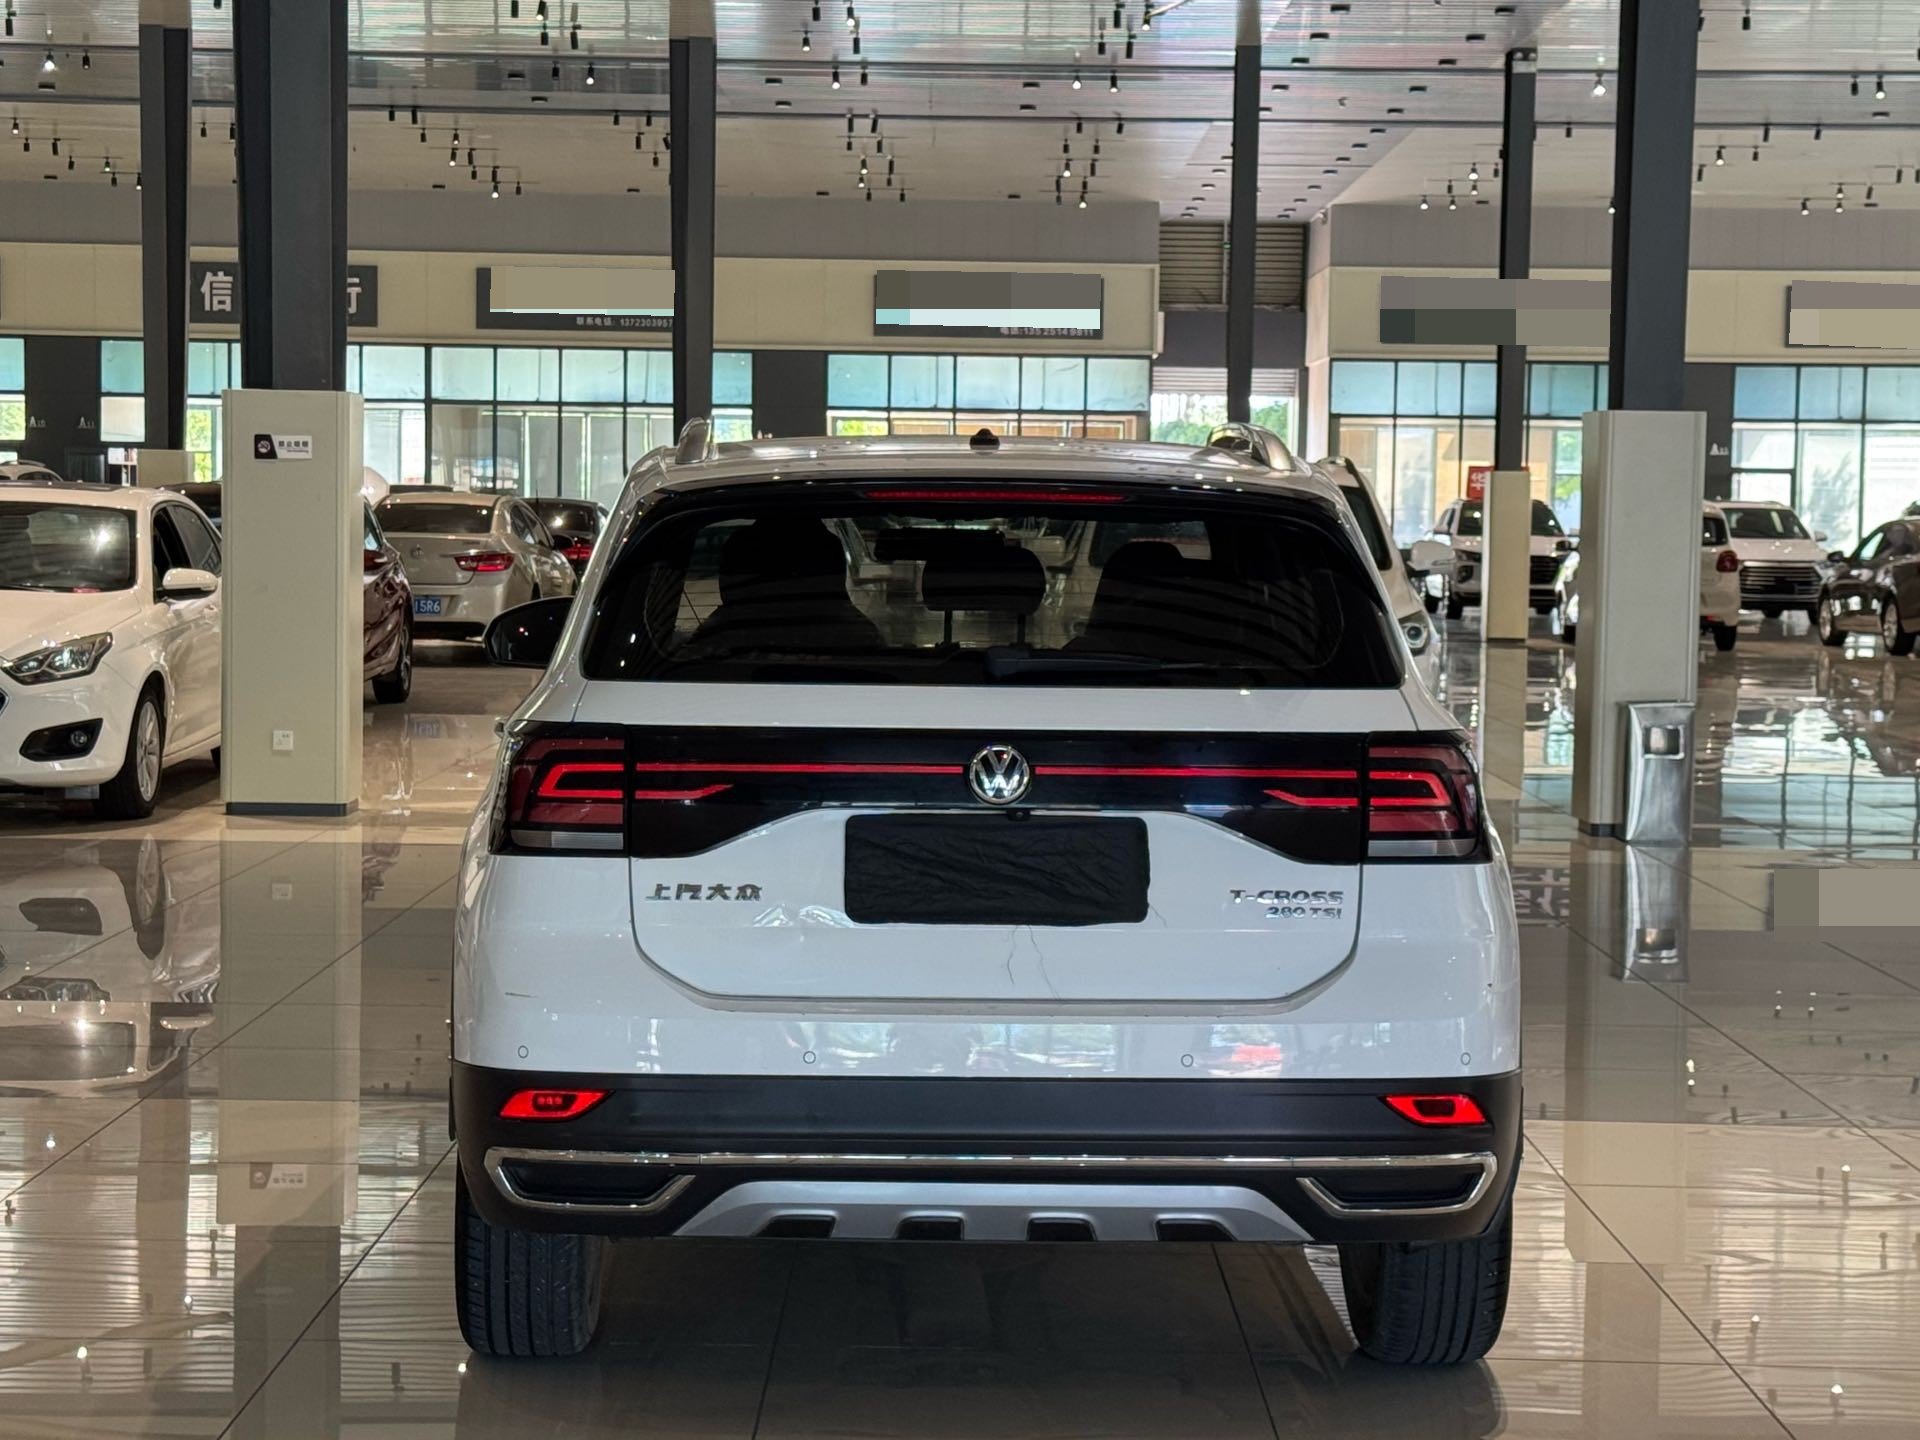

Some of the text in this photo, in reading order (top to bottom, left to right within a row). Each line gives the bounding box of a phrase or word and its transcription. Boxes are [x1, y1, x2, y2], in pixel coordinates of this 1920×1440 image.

[645, 883, 763, 901] 上汽大众
[1229, 889, 1344, 905] T-CROSS
[1265, 906, 1342, 919] 280 TSI
